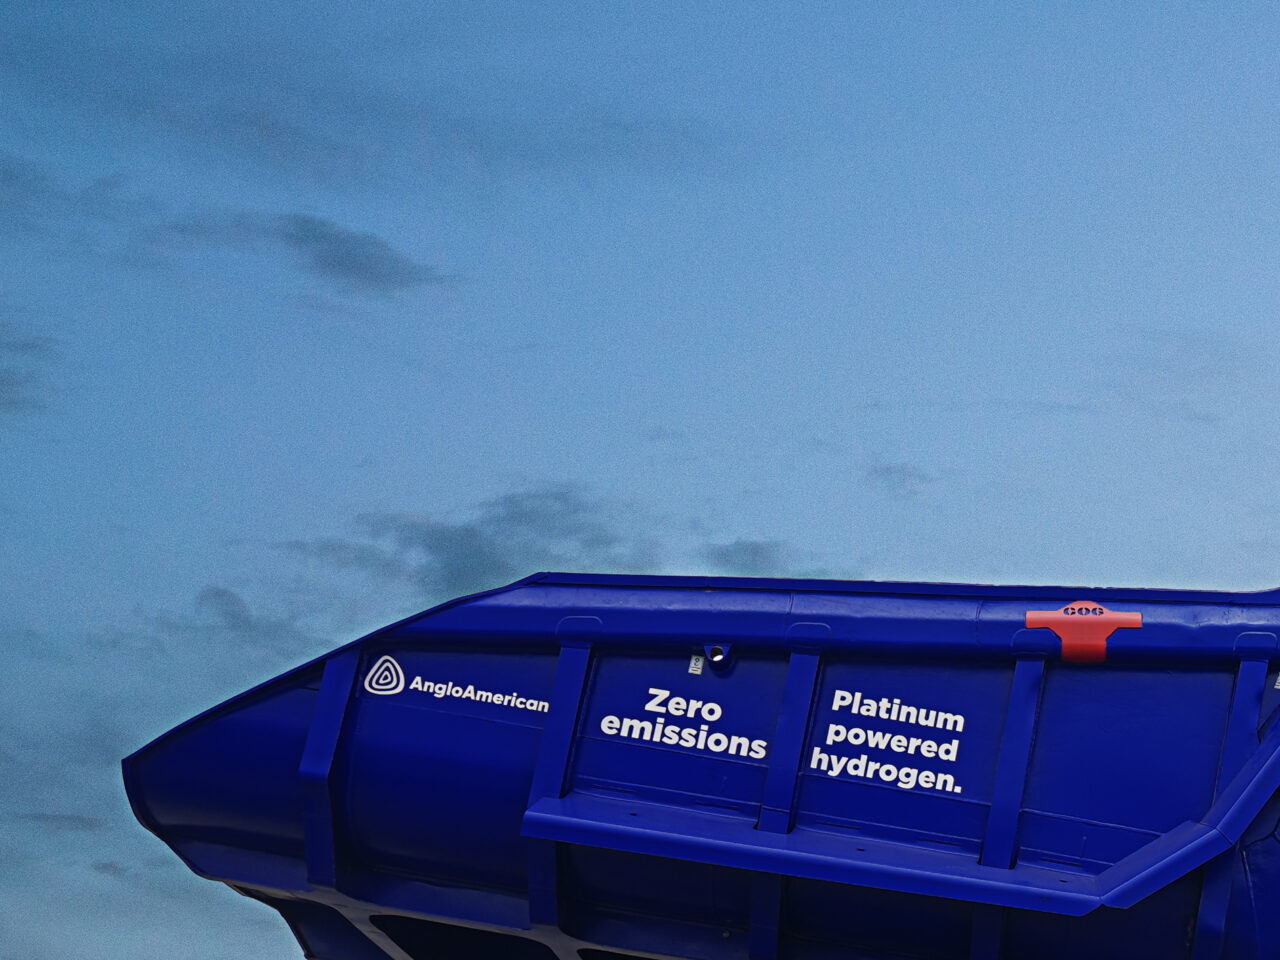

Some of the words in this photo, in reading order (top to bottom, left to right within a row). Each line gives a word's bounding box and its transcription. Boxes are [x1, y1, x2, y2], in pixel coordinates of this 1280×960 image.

[645, 688, 722, 721] Zero
[832, 690, 965, 732] Platinum
[600, 716, 768, 760] emissions
[826, 724, 960, 762] powered
[810, 747, 962, 794] hydrogen.
